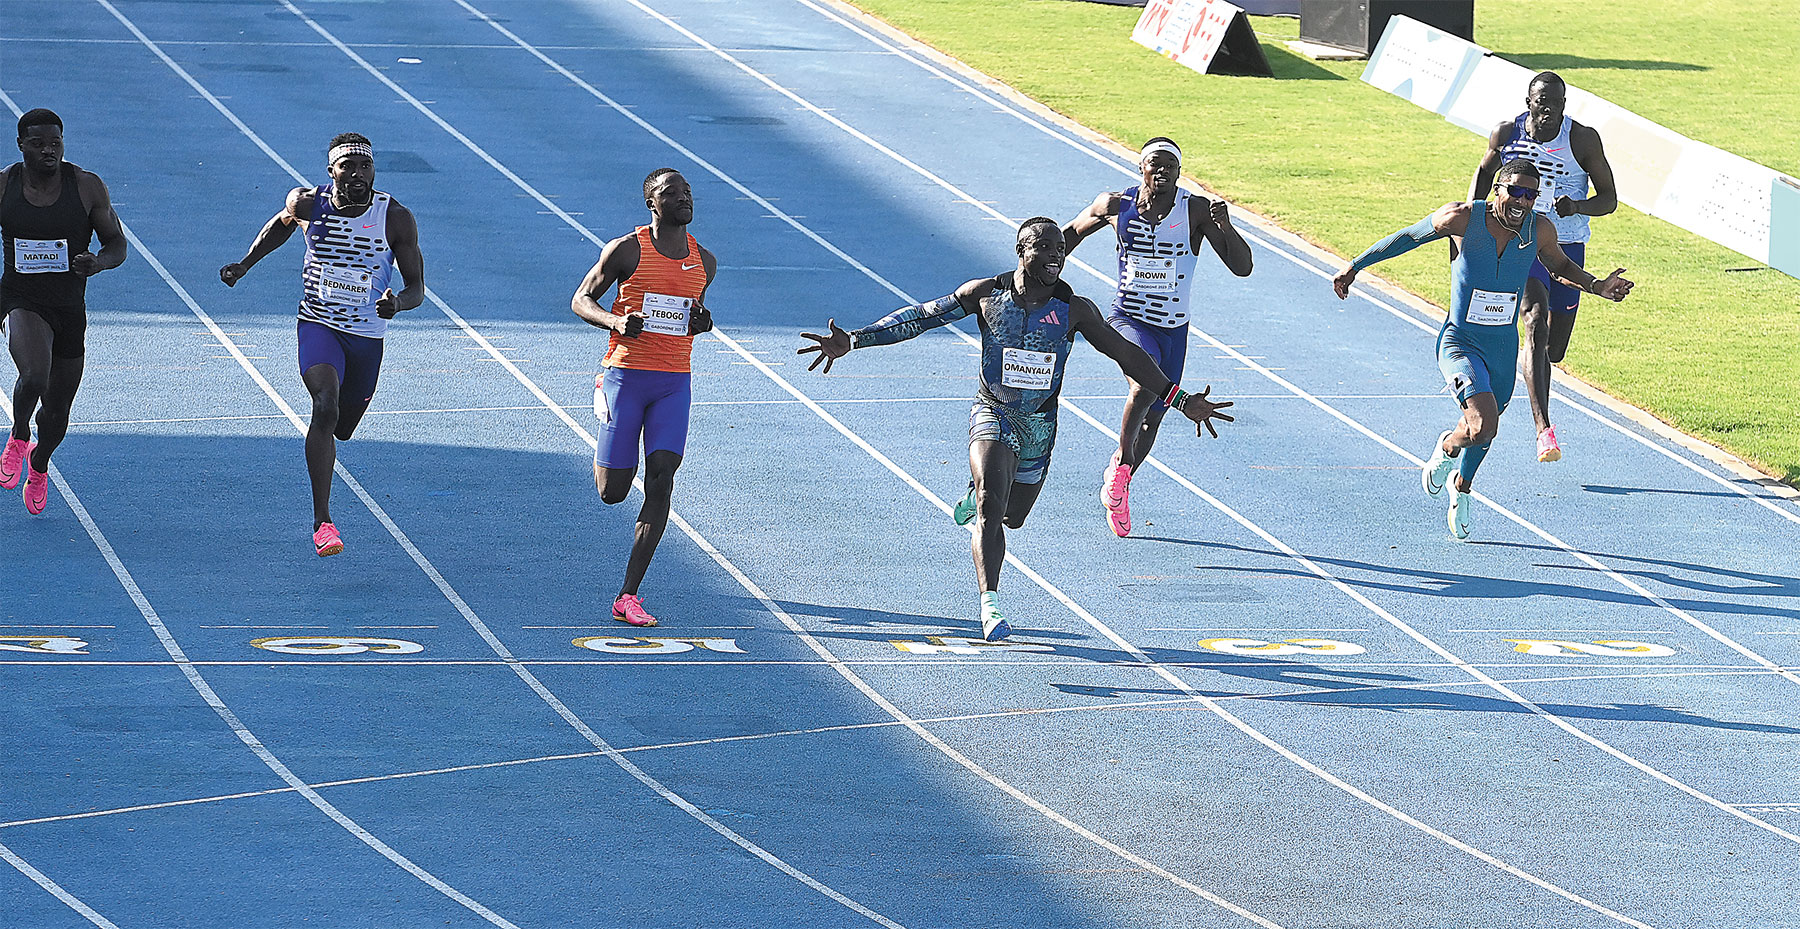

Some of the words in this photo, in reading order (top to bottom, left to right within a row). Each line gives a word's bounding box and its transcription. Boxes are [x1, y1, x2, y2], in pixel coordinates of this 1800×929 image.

[23, 253, 59, 261] MATADI
[1134, 270, 1167, 280] BROWN
[322, 278, 368, 293] BEDNAREK
[651, 309, 684, 321] TEBOGO
[1484, 304, 1505, 313] KING
[1004, 362, 1051, 375] OMANYALA
[250, 636, 424, 655] 6
[571, 636, 749, 655] 5
[888, 636, 1056, 655] 4
[1197, 638, 1368, 656] 3
[1501, 638, 1676, 657] 2
